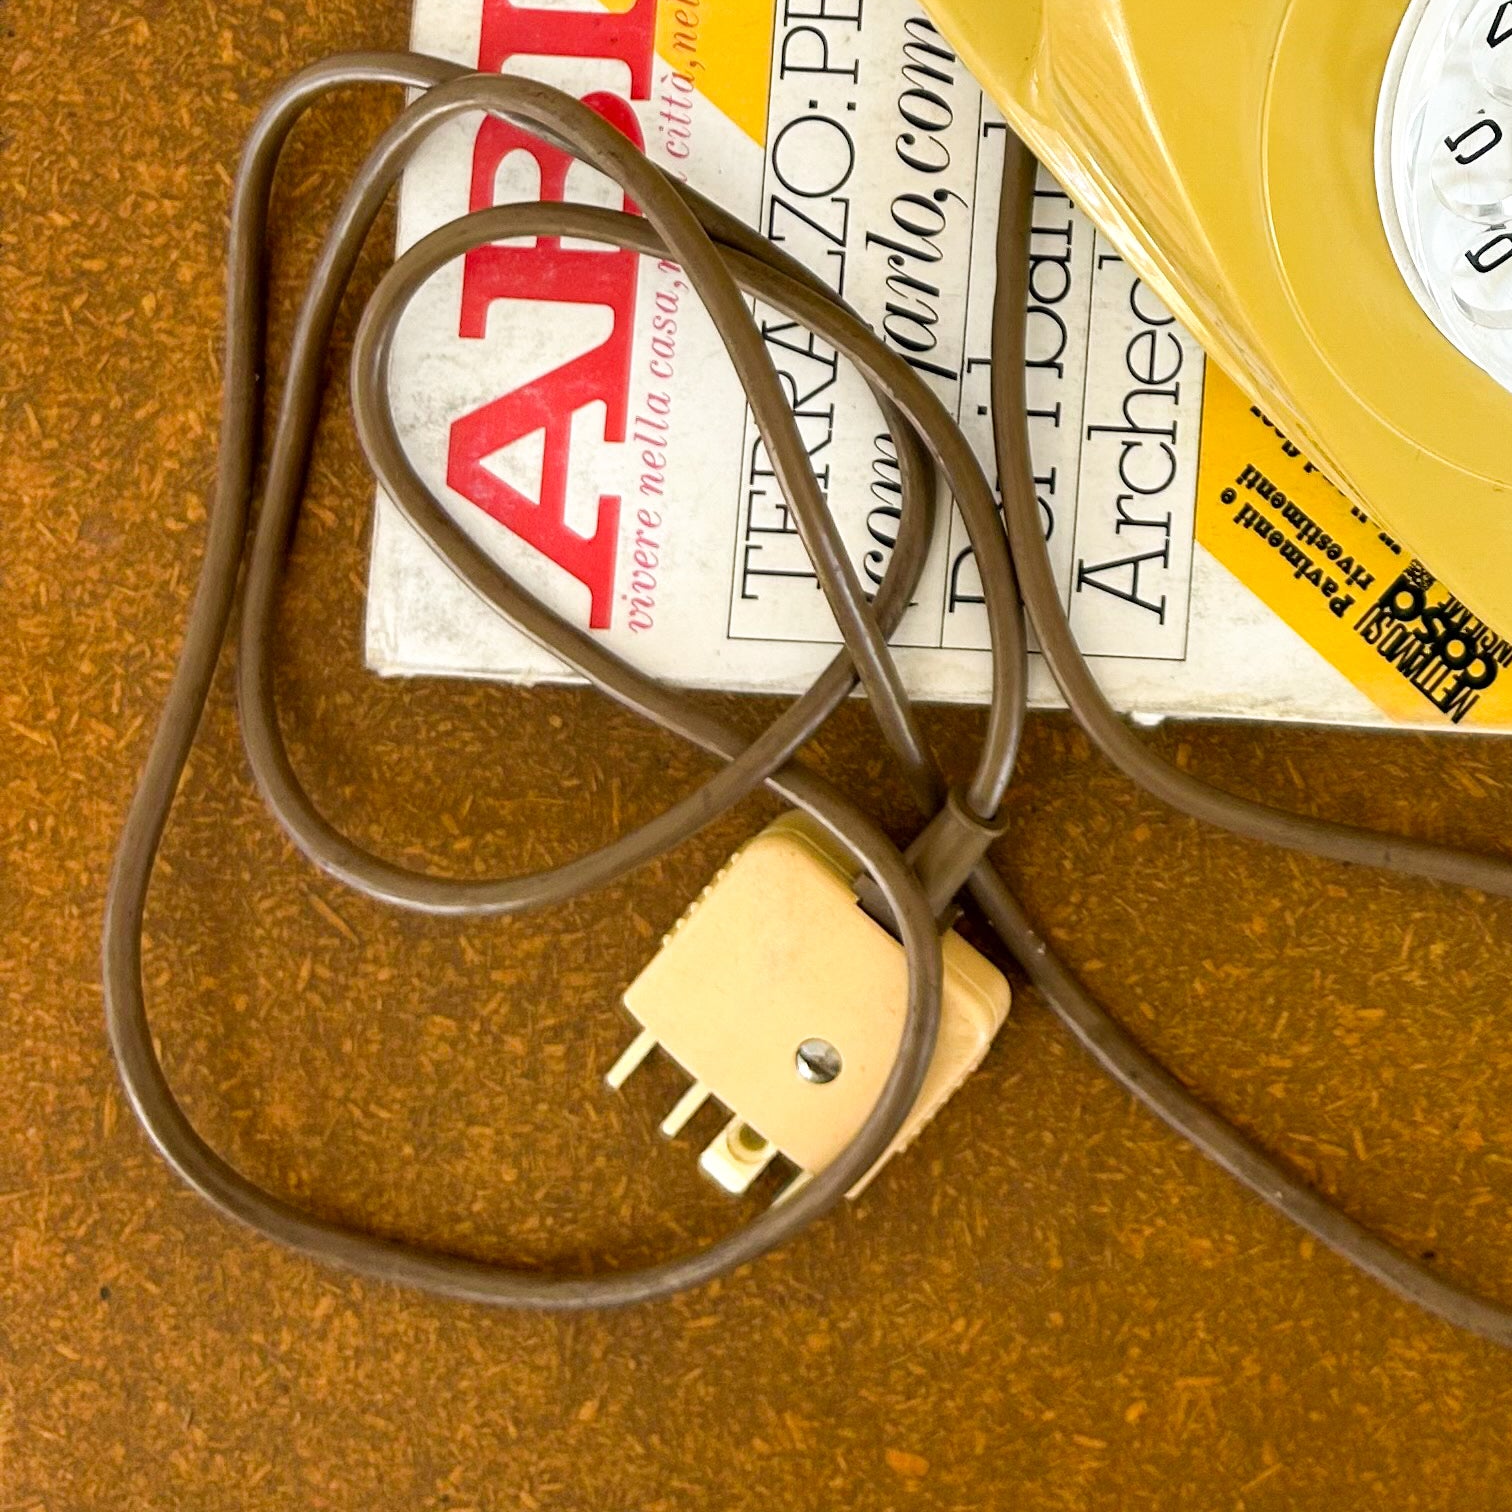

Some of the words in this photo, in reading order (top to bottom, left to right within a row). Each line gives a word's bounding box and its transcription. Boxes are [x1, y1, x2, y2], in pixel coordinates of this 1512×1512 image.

[648, 278, 690, 379] casa,
[633, 391, 672, 497] nella
[1076, 253, 1184, 626] Archeo
[1219, 487, 1238, 505] e
[621, 509, 663, 634] vivere
[1233, 502, 1356, 619] Pavimenti
[1235, 463, 1376, 591] rivestimenti
